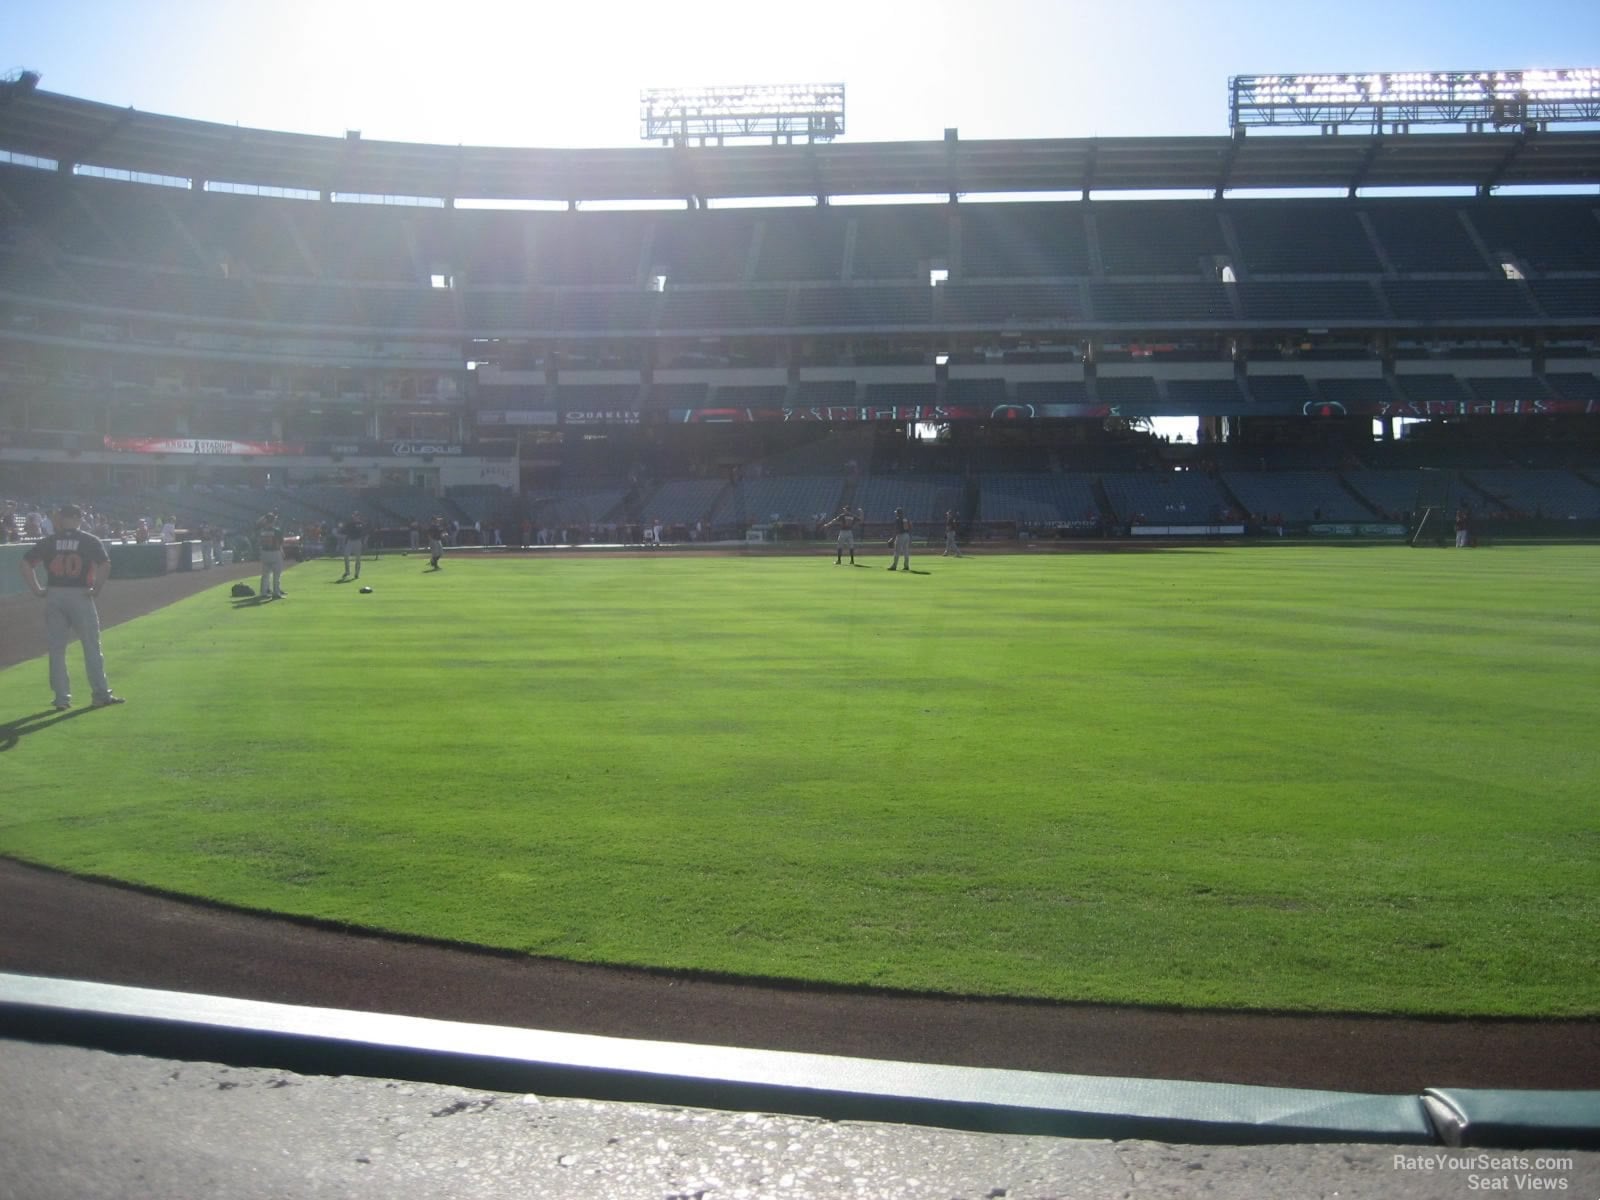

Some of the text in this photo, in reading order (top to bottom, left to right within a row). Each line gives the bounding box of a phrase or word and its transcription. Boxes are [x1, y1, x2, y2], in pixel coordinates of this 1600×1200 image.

[585, 411, 640, 419] OAKLEY
[411, 444, 462, 455] LEXUS
[48, 553, 83, 577] 40
